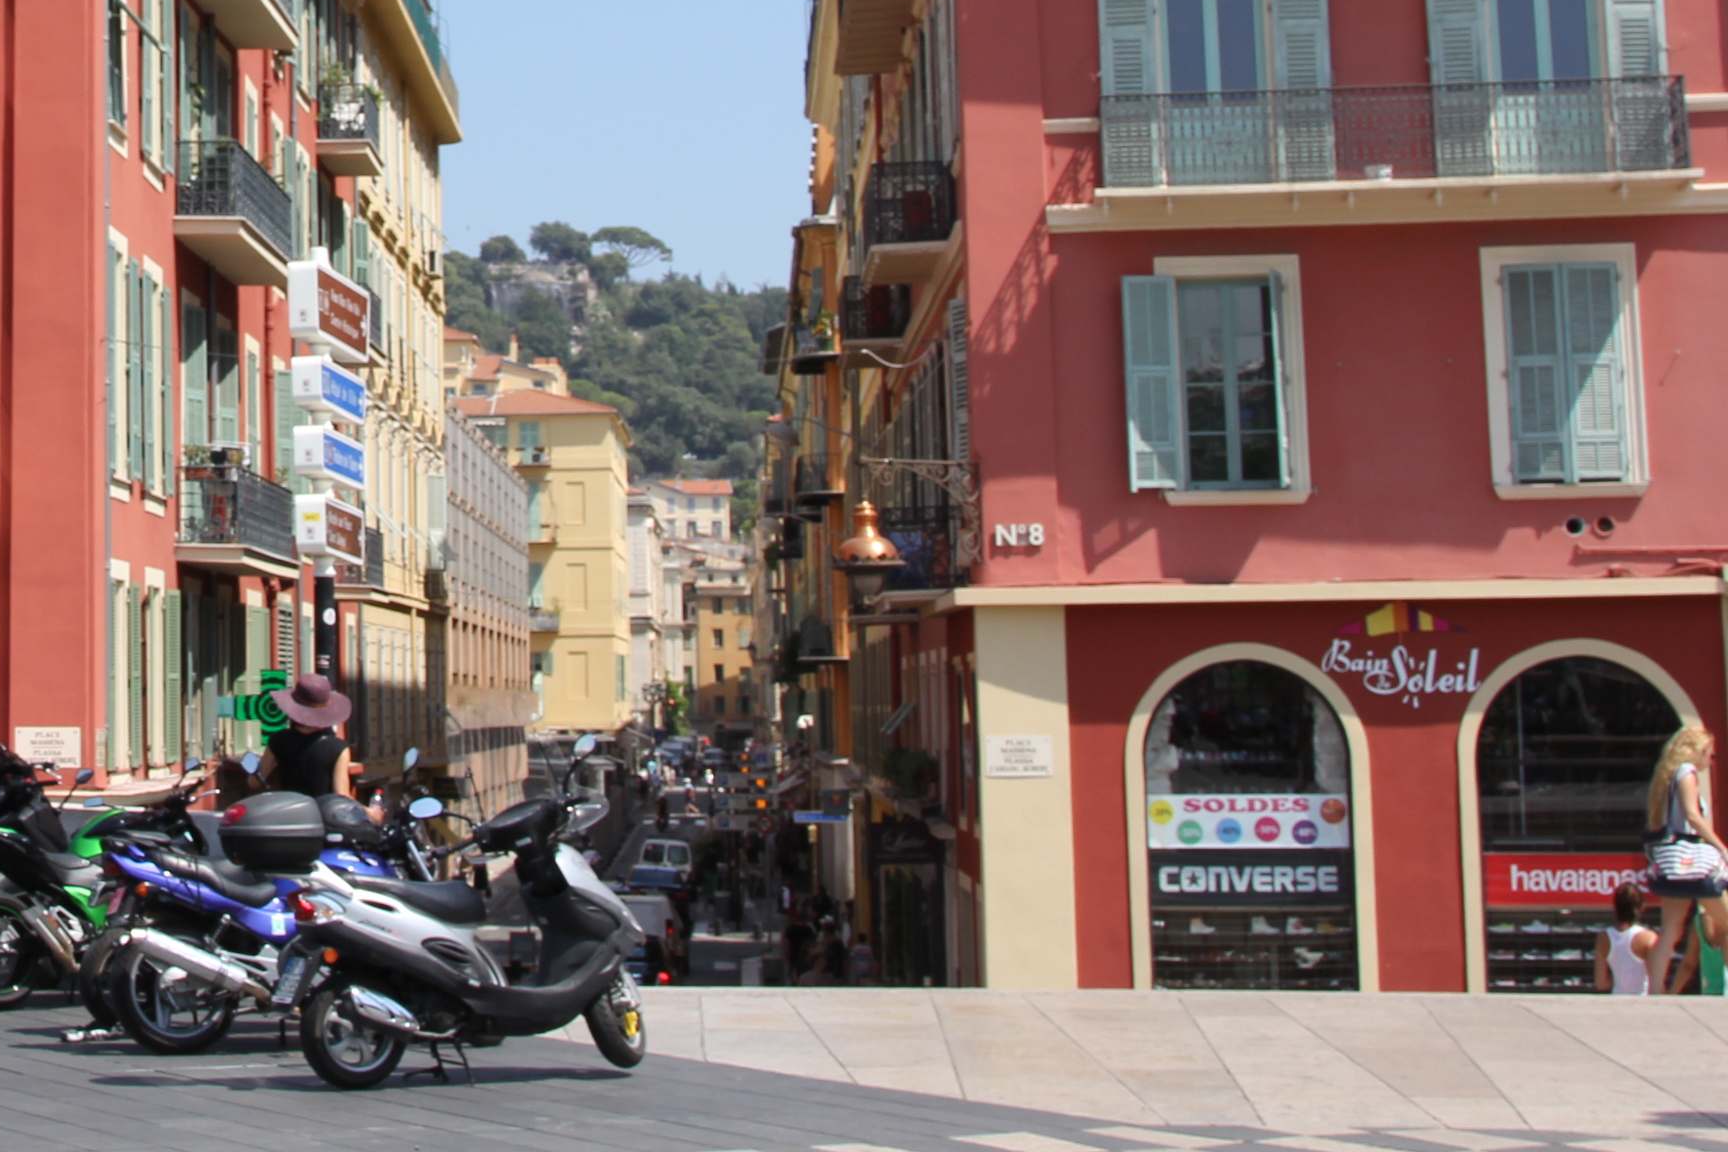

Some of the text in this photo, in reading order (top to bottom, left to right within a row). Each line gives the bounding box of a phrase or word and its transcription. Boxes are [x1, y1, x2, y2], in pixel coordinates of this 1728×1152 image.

[1321, 638, 1390, 673] Bain
[1363, 644, 1483, 695] Soleil
[1183, 797, 1310, 814] SOLDES
[1158, 865, 1339, 893] CONVERSE
[1509, 863, 1651, 895] havaianas
